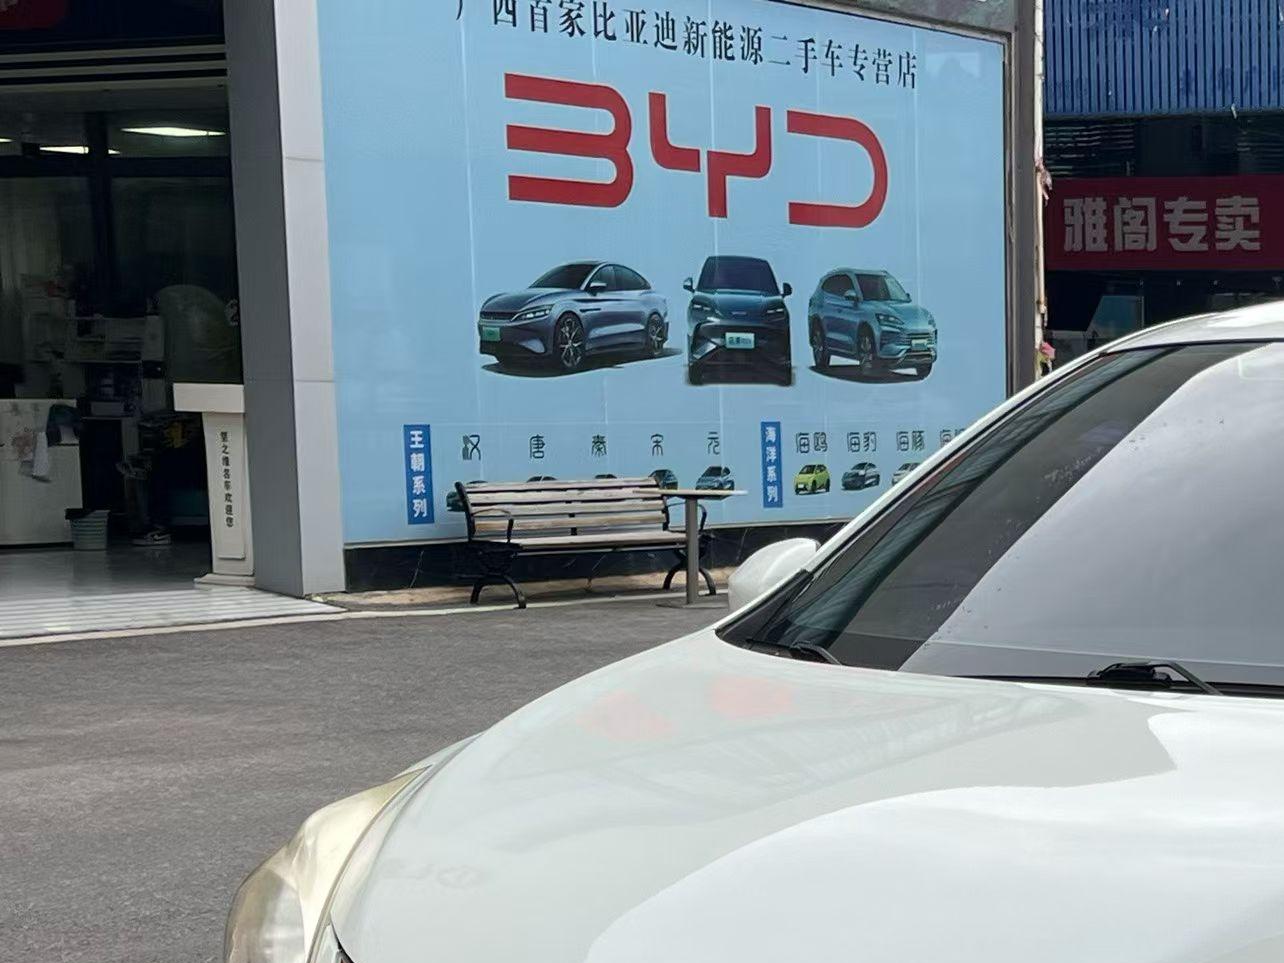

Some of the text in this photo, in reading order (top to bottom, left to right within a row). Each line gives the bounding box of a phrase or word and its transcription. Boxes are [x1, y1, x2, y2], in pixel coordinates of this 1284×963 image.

[456, 0, 918, 89] 西首家比亚迪新能源二手车专营店
[503, 71, 889, 229] BYD
[1063, 196, 1262, 252] 雅阁专卖
[408, 430, 427, 518] 王朝系列
[529, 434, 546, 459] 唐
[650, 433, 664, 457] 宋
[707, 431, 721, 455] 元
[764, 426, 779, 503] 海洋系列
[847, 431, 877, 453] 海豹
[896, 430, 925, 452] 海豚
